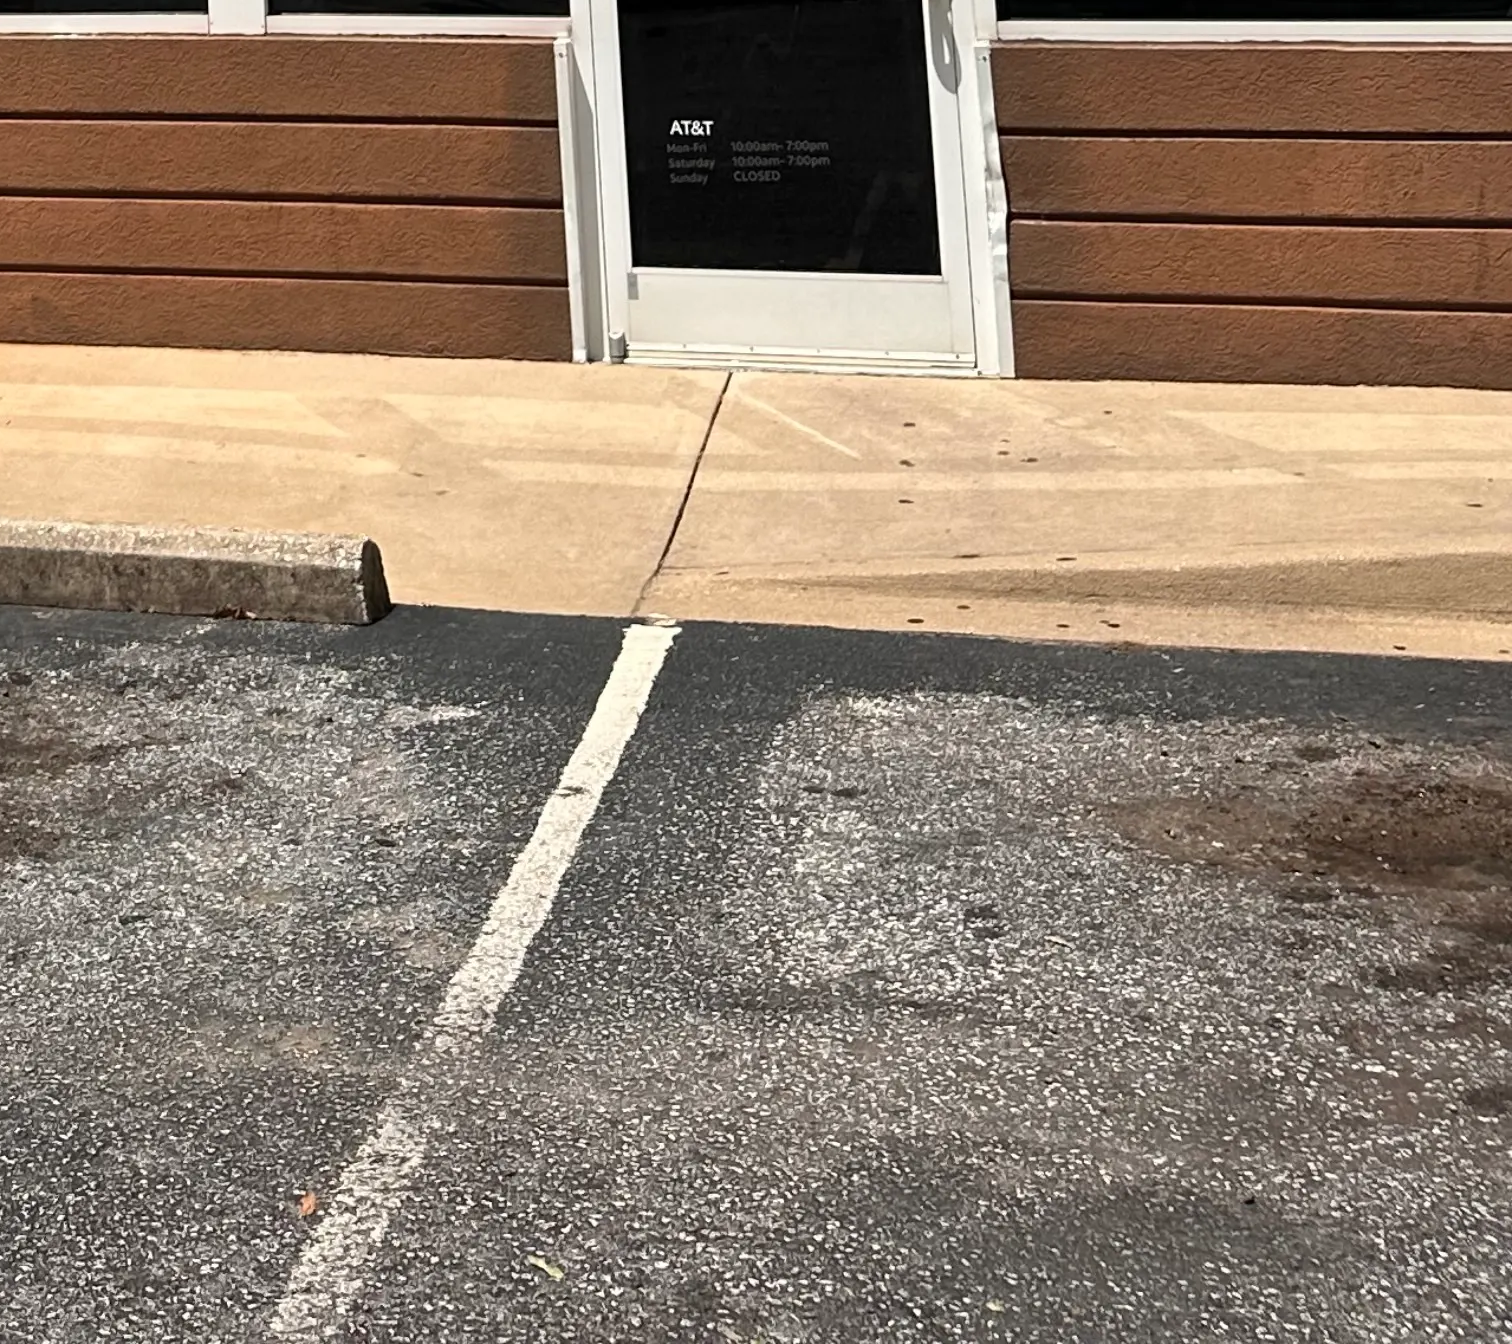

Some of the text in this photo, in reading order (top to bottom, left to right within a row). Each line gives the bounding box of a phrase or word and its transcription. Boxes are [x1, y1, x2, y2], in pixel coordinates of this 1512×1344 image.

[669, 119, 715, 137] AT&T
[666, 141, 707, 154] Mon-Fri
[785, 139, 830, 153] 7:00pm
[668, 157, 716, 171] Saturday
[786, 154, 831, 169] 7:00pm
[669, 170, 781, 186] Sunday CLOSED
